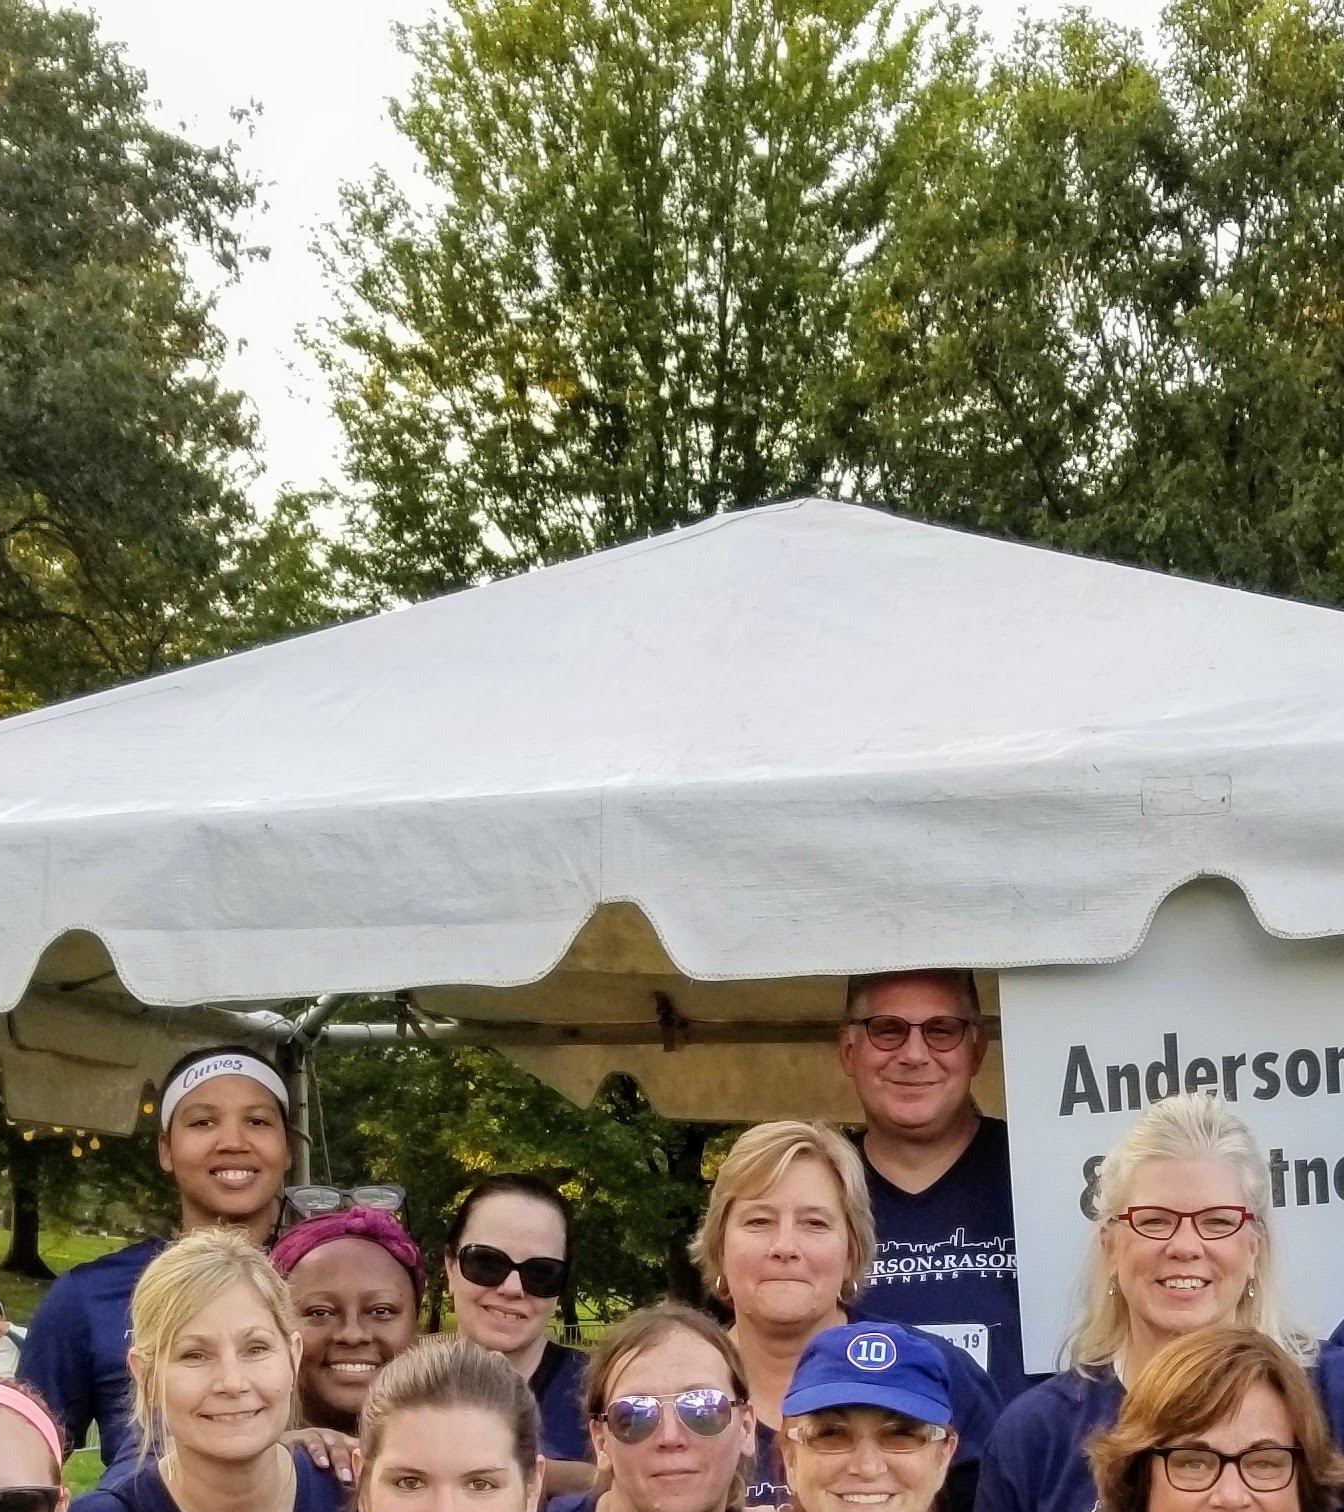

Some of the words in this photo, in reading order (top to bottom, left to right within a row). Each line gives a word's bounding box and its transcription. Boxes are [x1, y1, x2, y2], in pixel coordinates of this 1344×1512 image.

[183, 1060, 243, 1088] Curves
[944, 1254, 1017, 1269] RASOR
[870, 1272, 958, 1286] RTNERS
[963, 1333, 979, 1348] 19
[857, 1341, 886, 1362] 10
